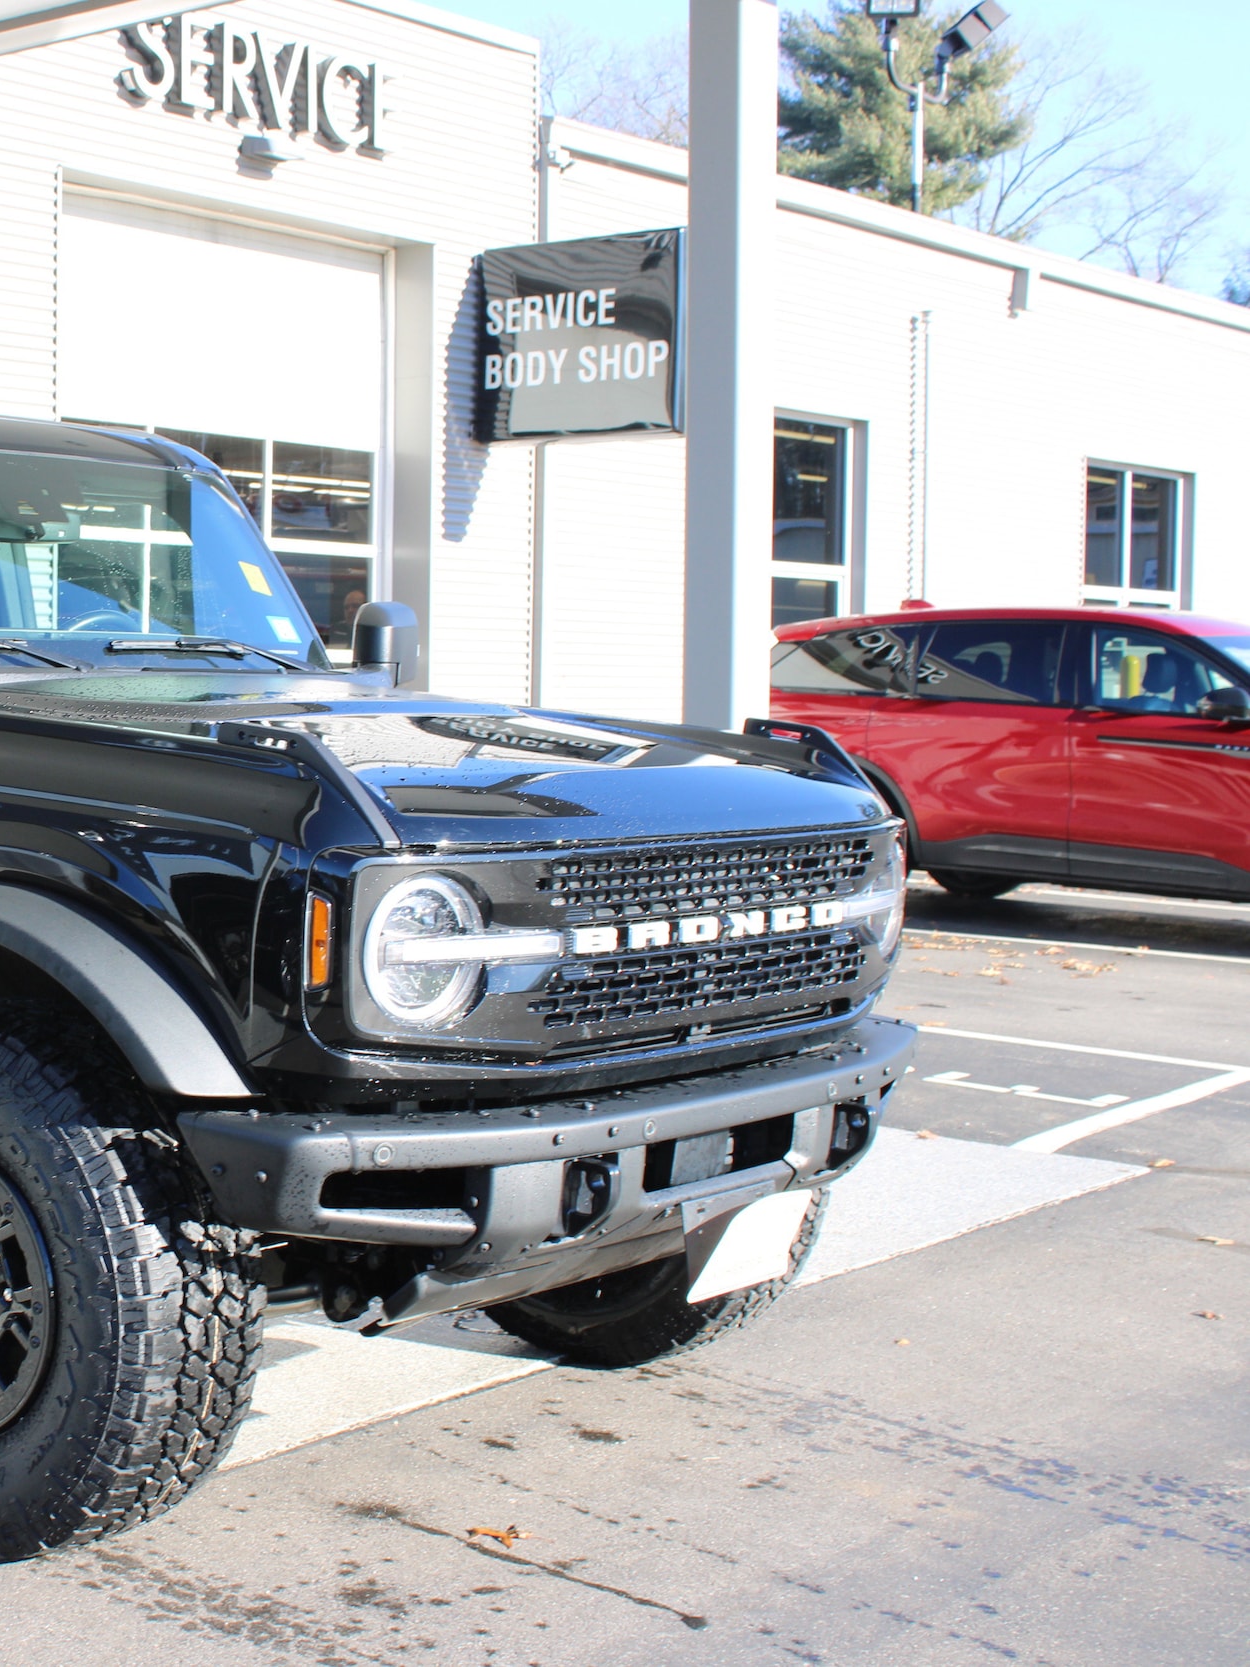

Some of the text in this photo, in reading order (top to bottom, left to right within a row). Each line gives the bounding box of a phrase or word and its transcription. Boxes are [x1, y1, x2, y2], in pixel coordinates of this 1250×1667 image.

[486, 288, 616, 336] SERVICE
[485, 340, 669, 390] BODY SHOP
[571, 901, 843, 954] BRONCO
